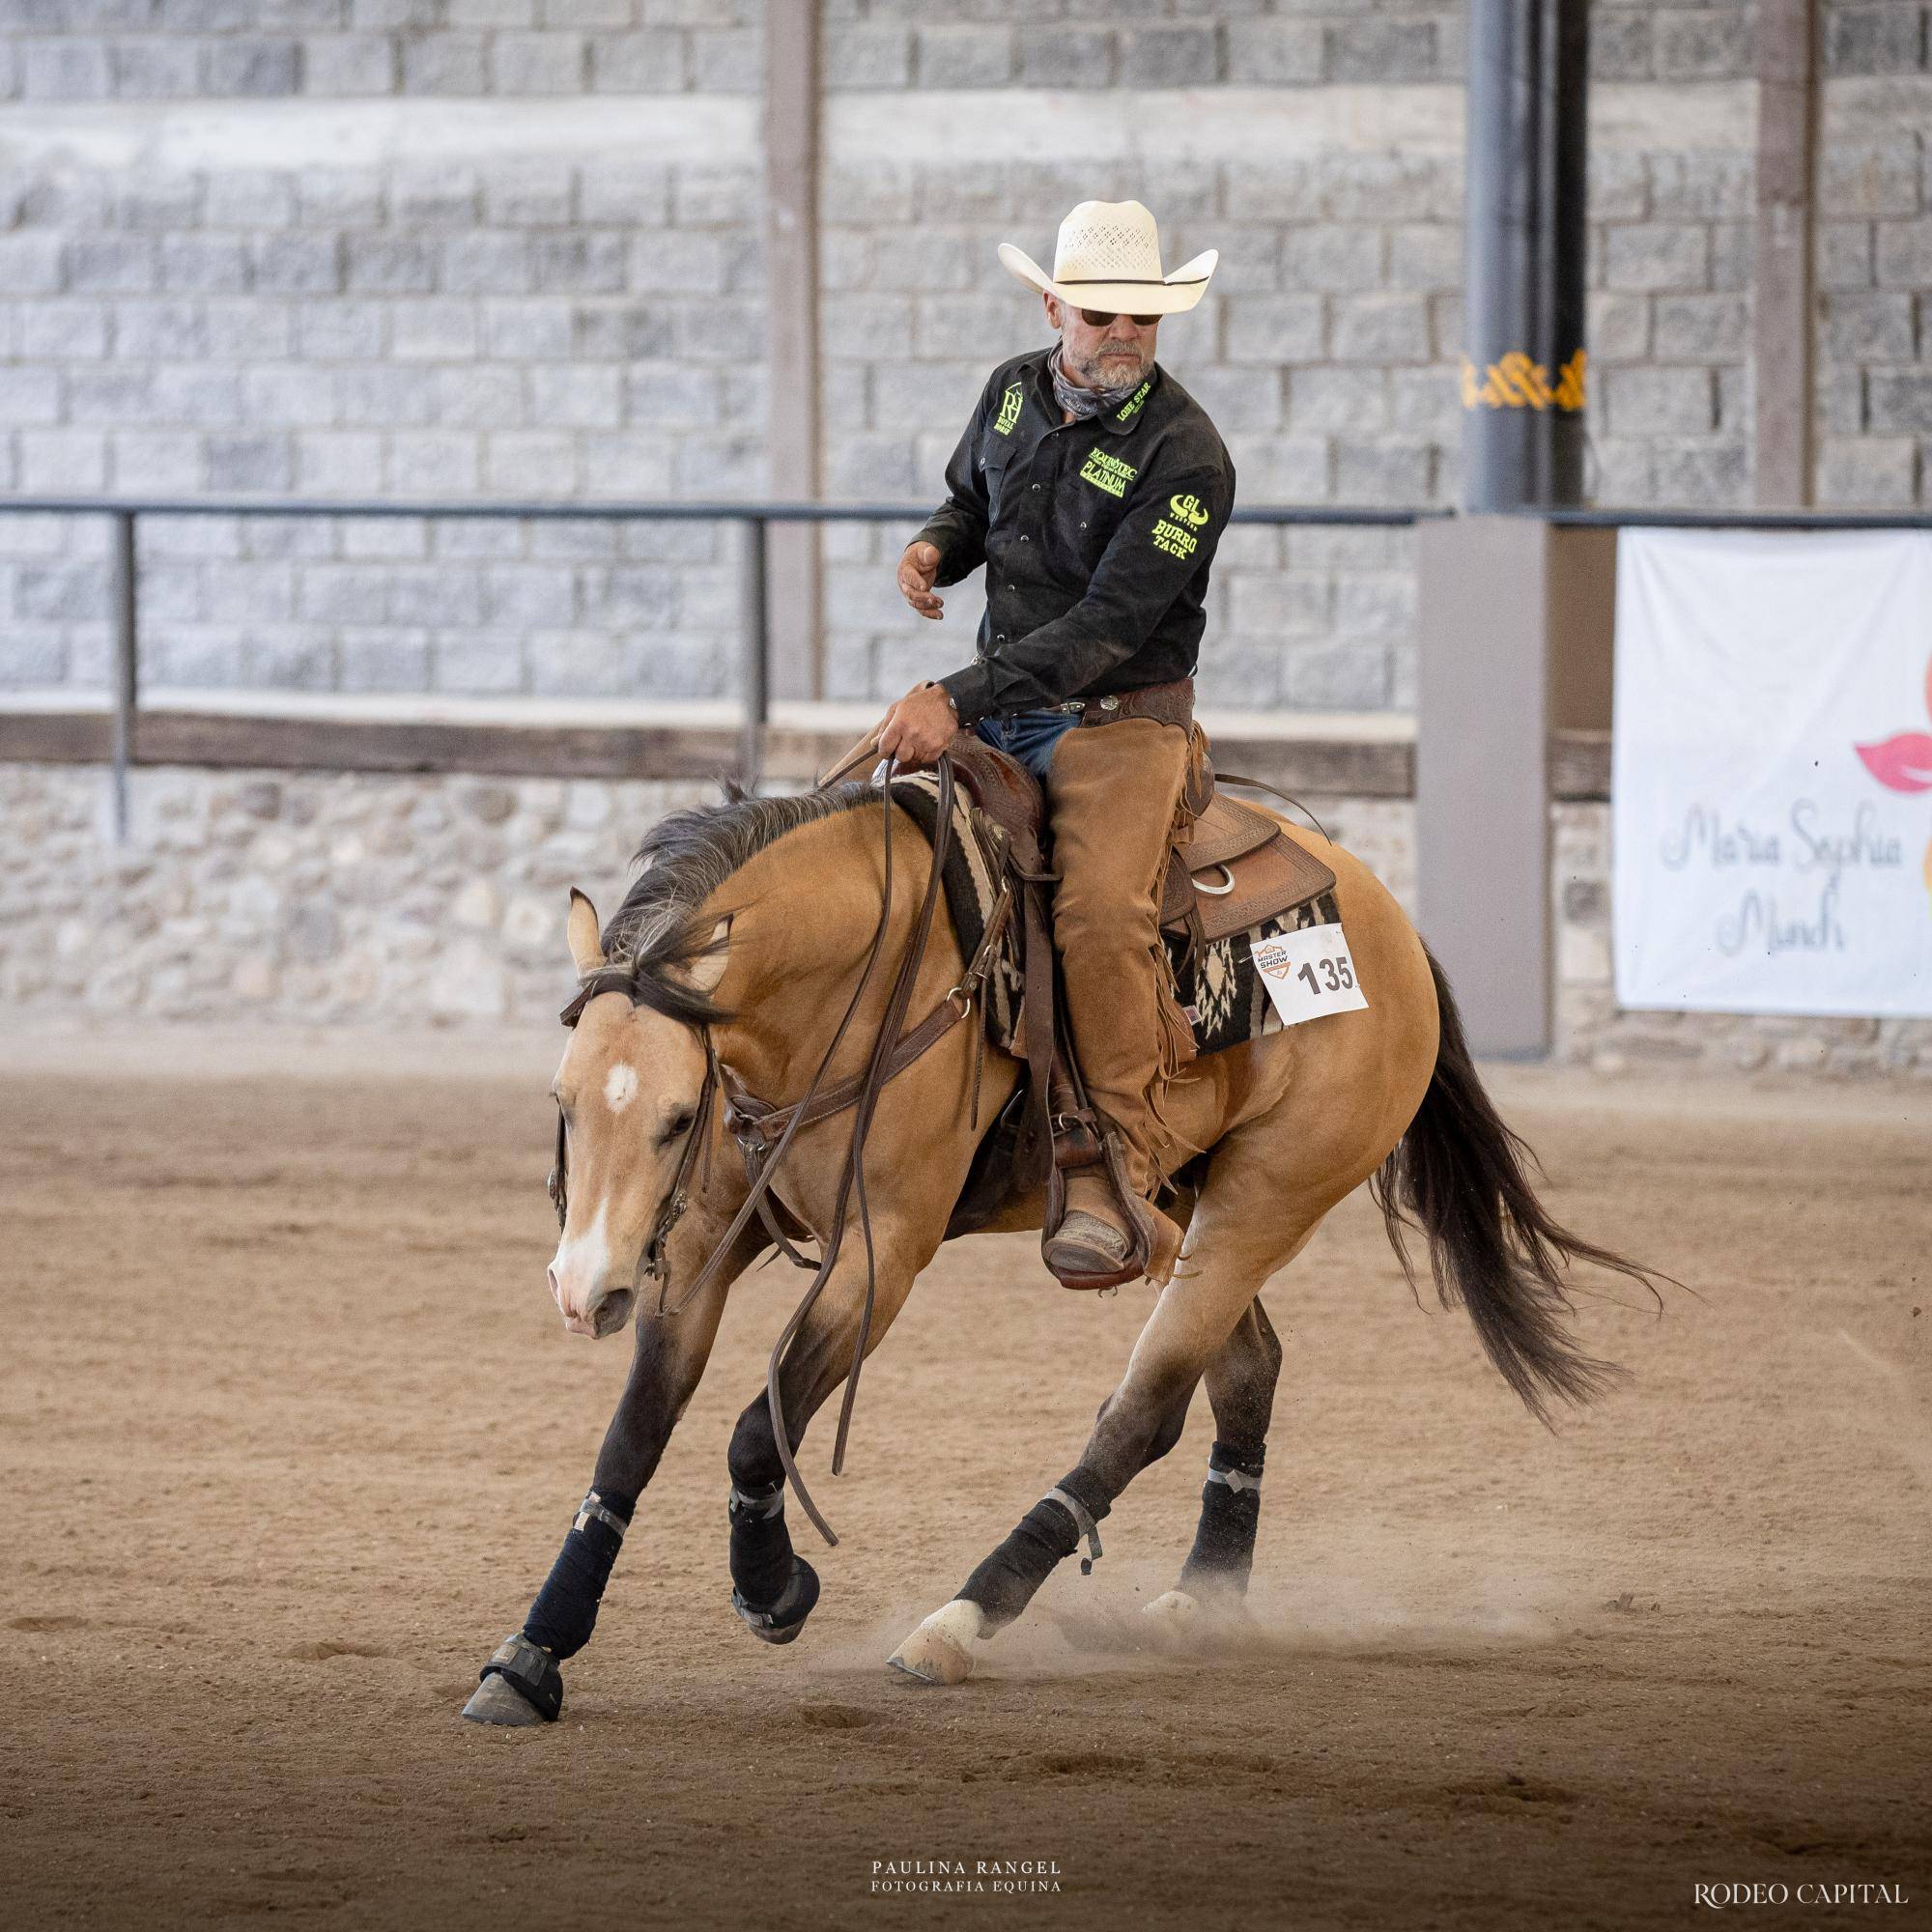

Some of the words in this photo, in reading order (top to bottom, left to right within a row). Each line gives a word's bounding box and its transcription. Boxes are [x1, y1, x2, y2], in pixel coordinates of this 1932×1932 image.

[1116, 401, 1135, 421] LONE
[1133, 382, 1151, 403] STAR
[1082, 461, 1126, 494] PLATINUM
[1182, 495, 1201, 516] GL
[1151, 519, 1198, 554] BURRO
[1152, 535, 1187, 560] TACK
[1257, 950, 1288, 963] MASTER
[1260, 955, 1290, 969] SHOW
[1297, 956, 1353, 996] 135
